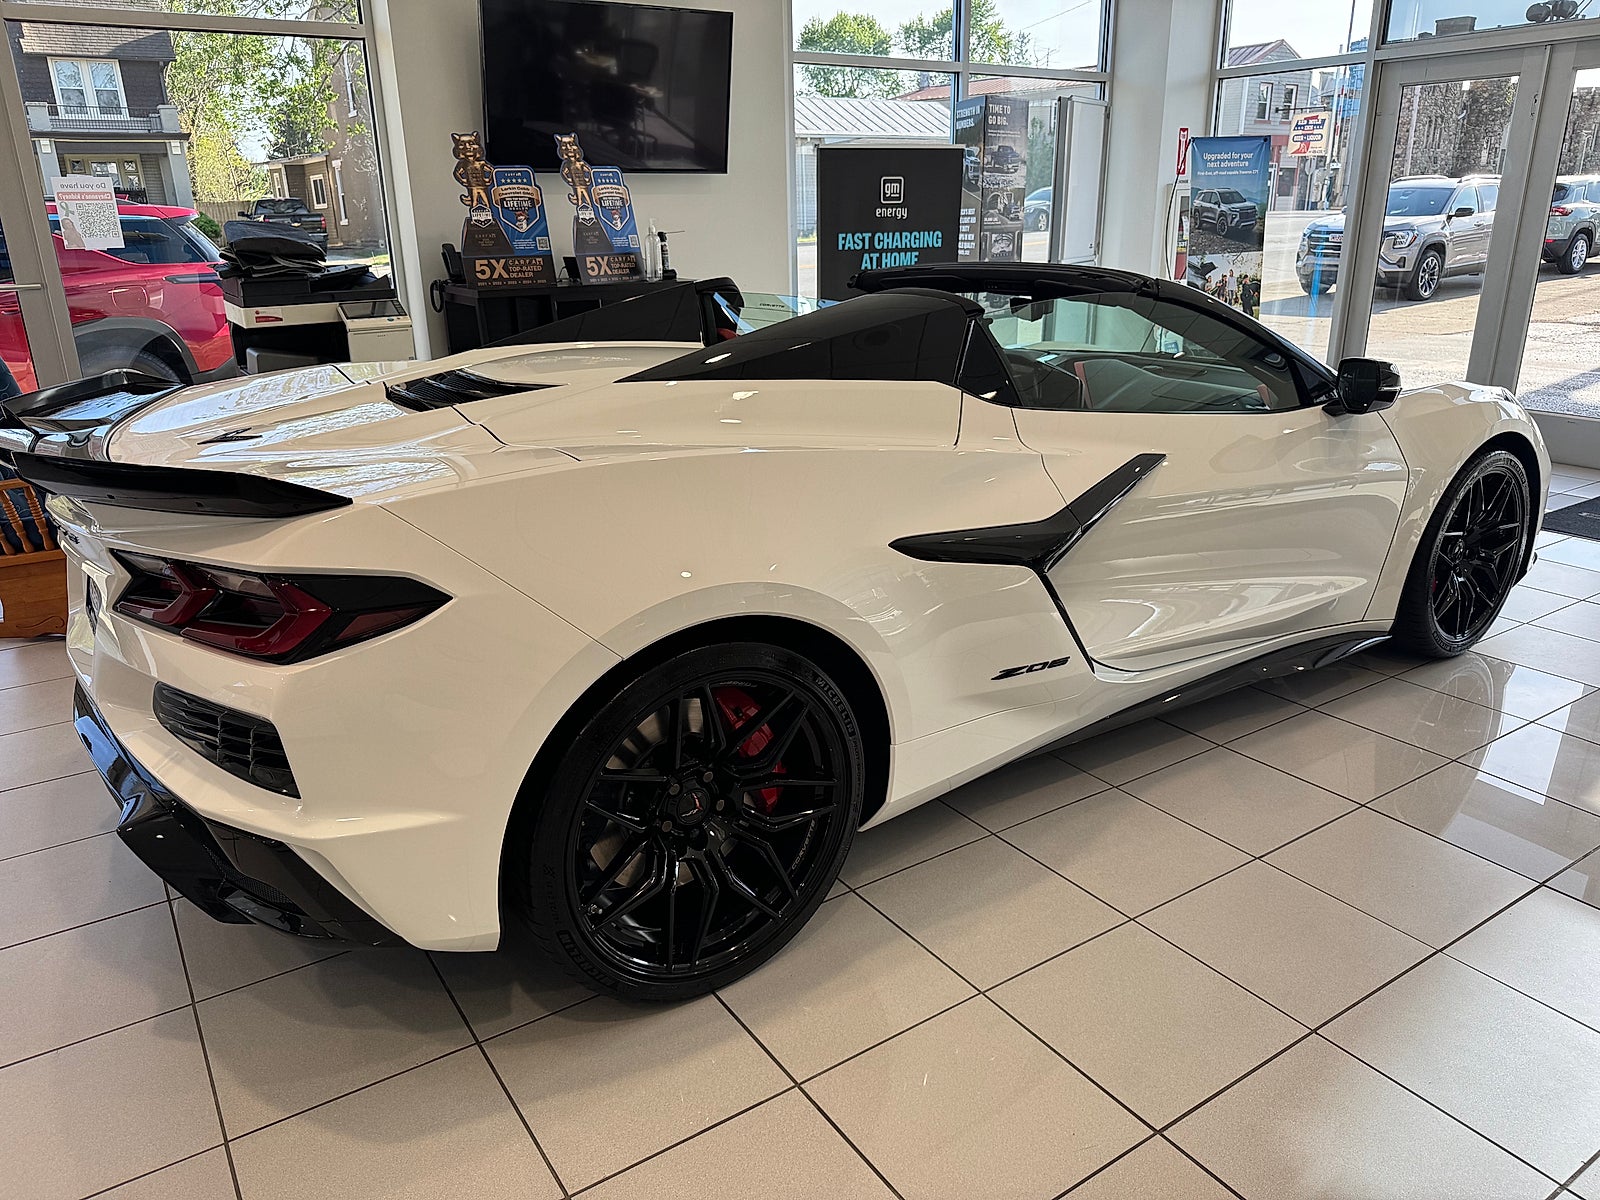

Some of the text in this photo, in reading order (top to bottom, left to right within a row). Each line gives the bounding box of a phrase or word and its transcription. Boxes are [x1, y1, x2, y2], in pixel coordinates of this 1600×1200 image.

[988, 104, 1011, 114] TIME TO
[988, 116, 1008, 126] GO BIG.
[1203, 152, 1231, 160] Upgraded
[884, 182, 900, 197] gm
[876, 207, 908, 219] energy
[838, 231, 942, 250] FAST CHARGING
[475, 259, 510, 280] 5X
[586, 256, 612, 276] 5X
[861, 253, 879, 270] AT
[990, 656, 1070, 680] Z06
[815, 676, 856, 737] MICHELIN
